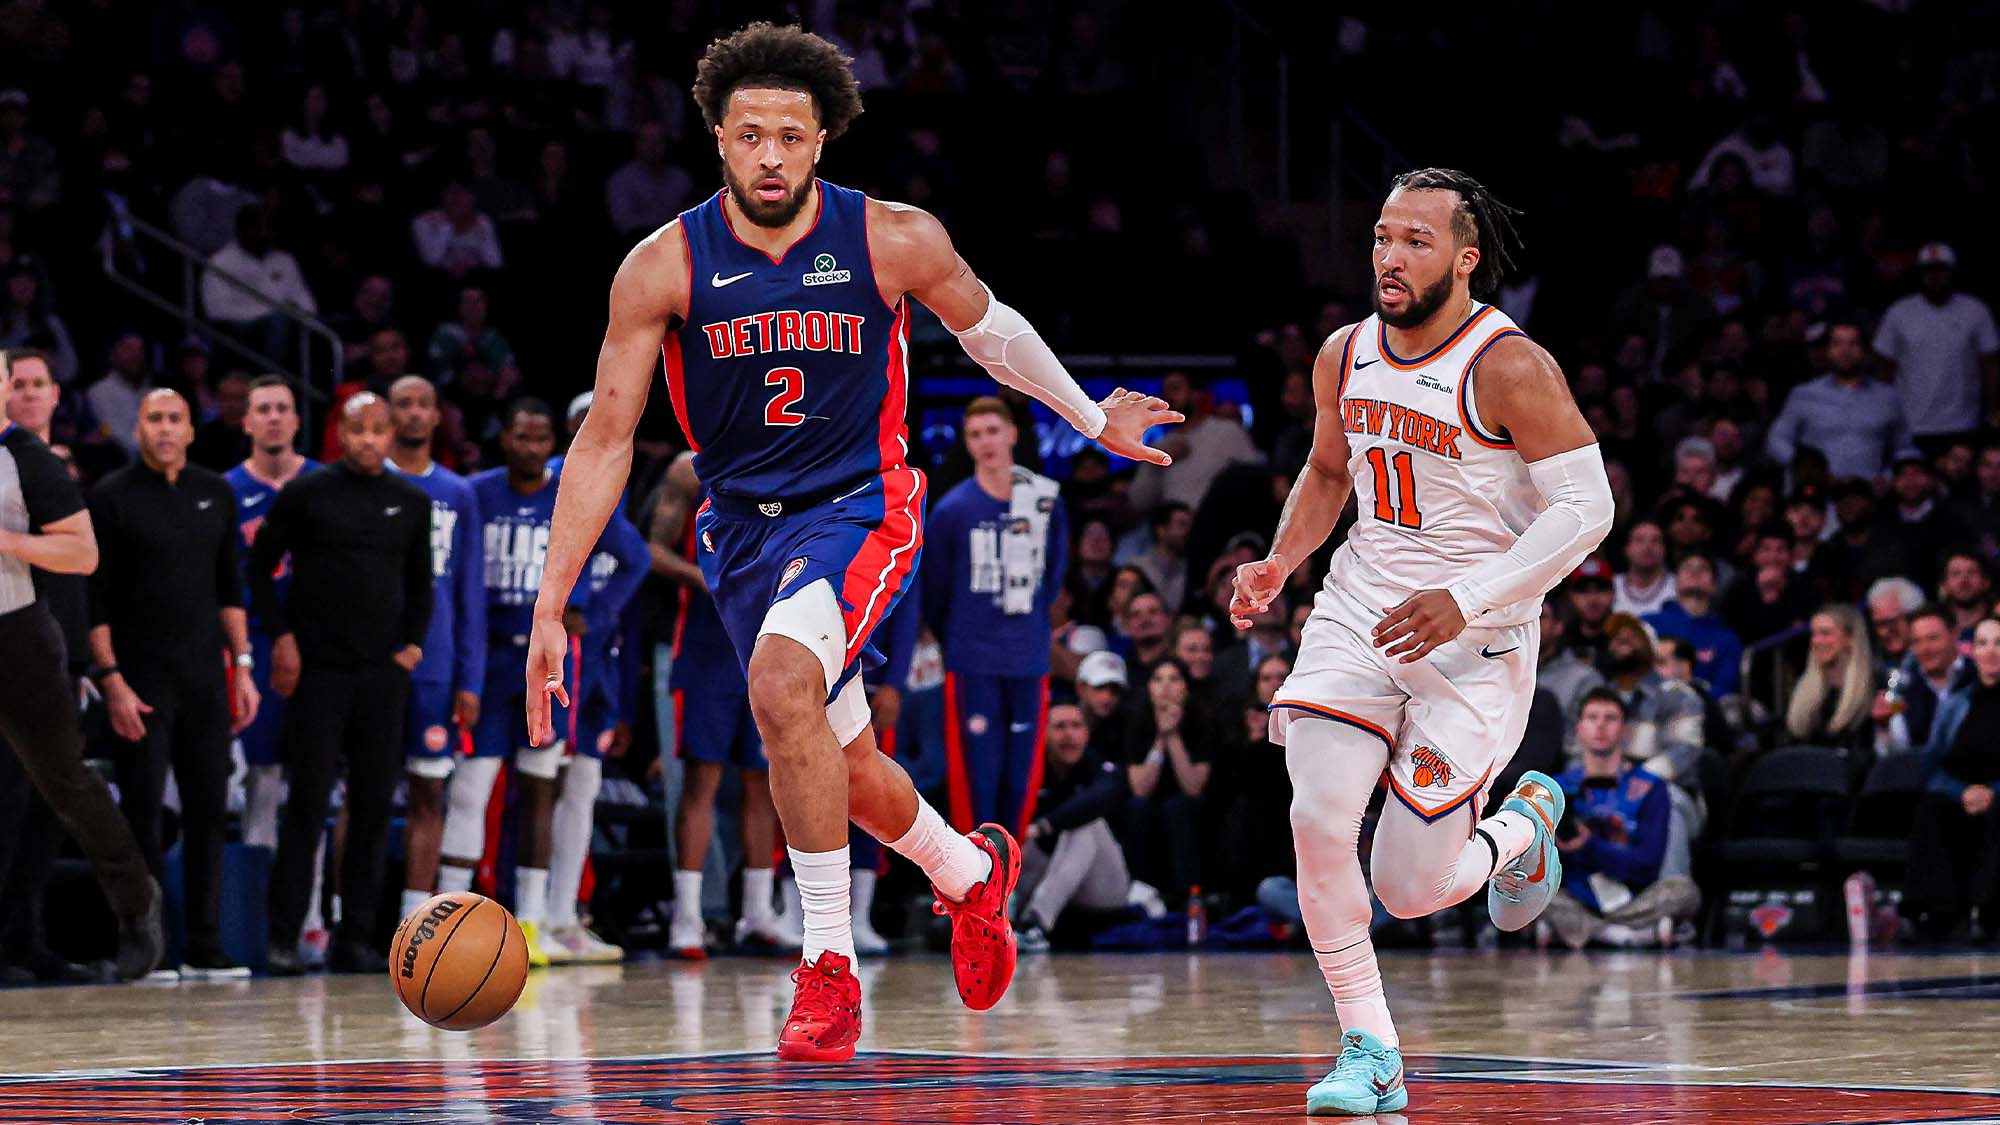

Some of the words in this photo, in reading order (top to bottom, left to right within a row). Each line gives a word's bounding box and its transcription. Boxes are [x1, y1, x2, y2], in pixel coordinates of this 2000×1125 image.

[804, 271, 849, 284] StockX
[702, 310, 865, 359] DETROIT
[764, 366, 806, 426] 2
[1344, 397, 1387, 435] NEW
[1388, 402, 1462, 460] YORK
[1366, 447, 1422, 530] 11
[1410, 746, 1452, 787] KNICKS
[401, 900, 464, 979] Wilson
